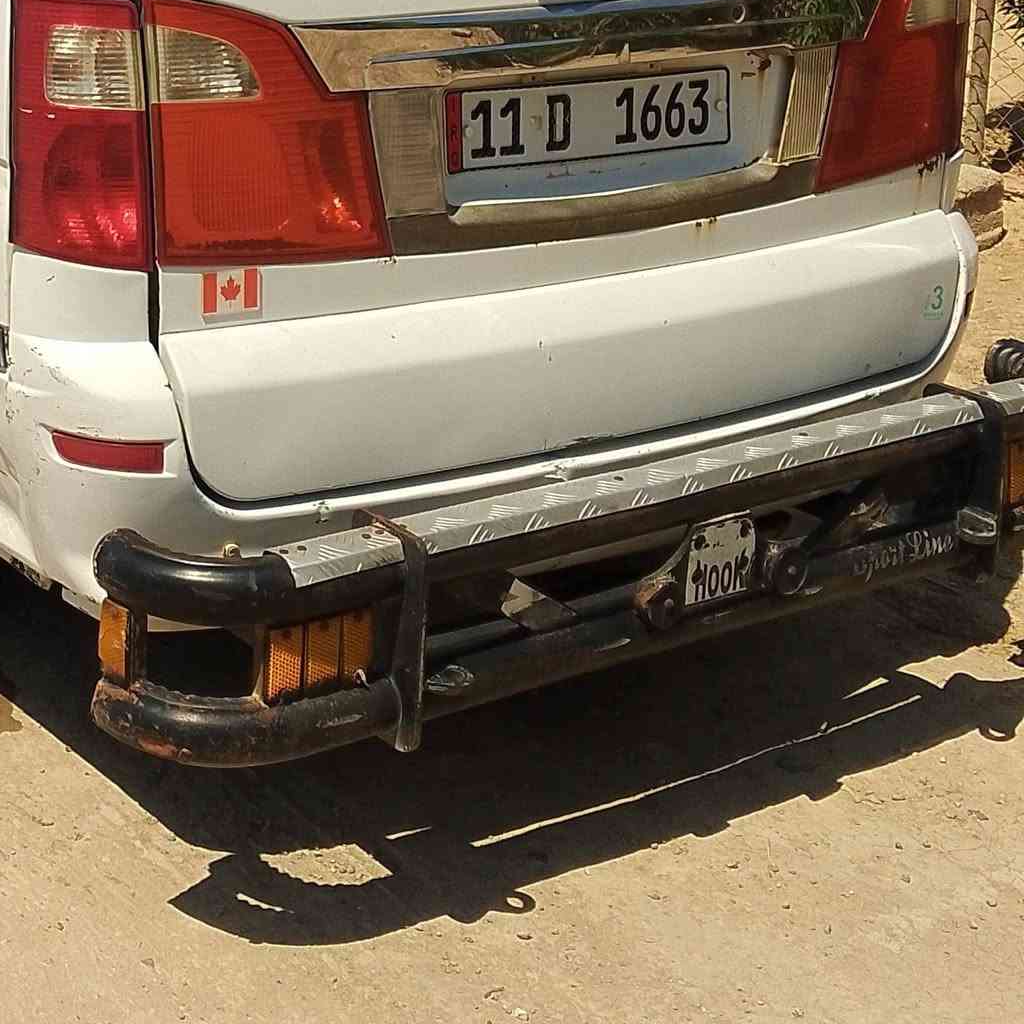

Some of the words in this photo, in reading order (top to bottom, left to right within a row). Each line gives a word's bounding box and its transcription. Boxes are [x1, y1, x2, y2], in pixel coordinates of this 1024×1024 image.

[470, 98, 525, 159] 11
[546, 93, 571, 152] D
[615, 79, 709, 144] 1663
[906, 530, 954, 560] Line
